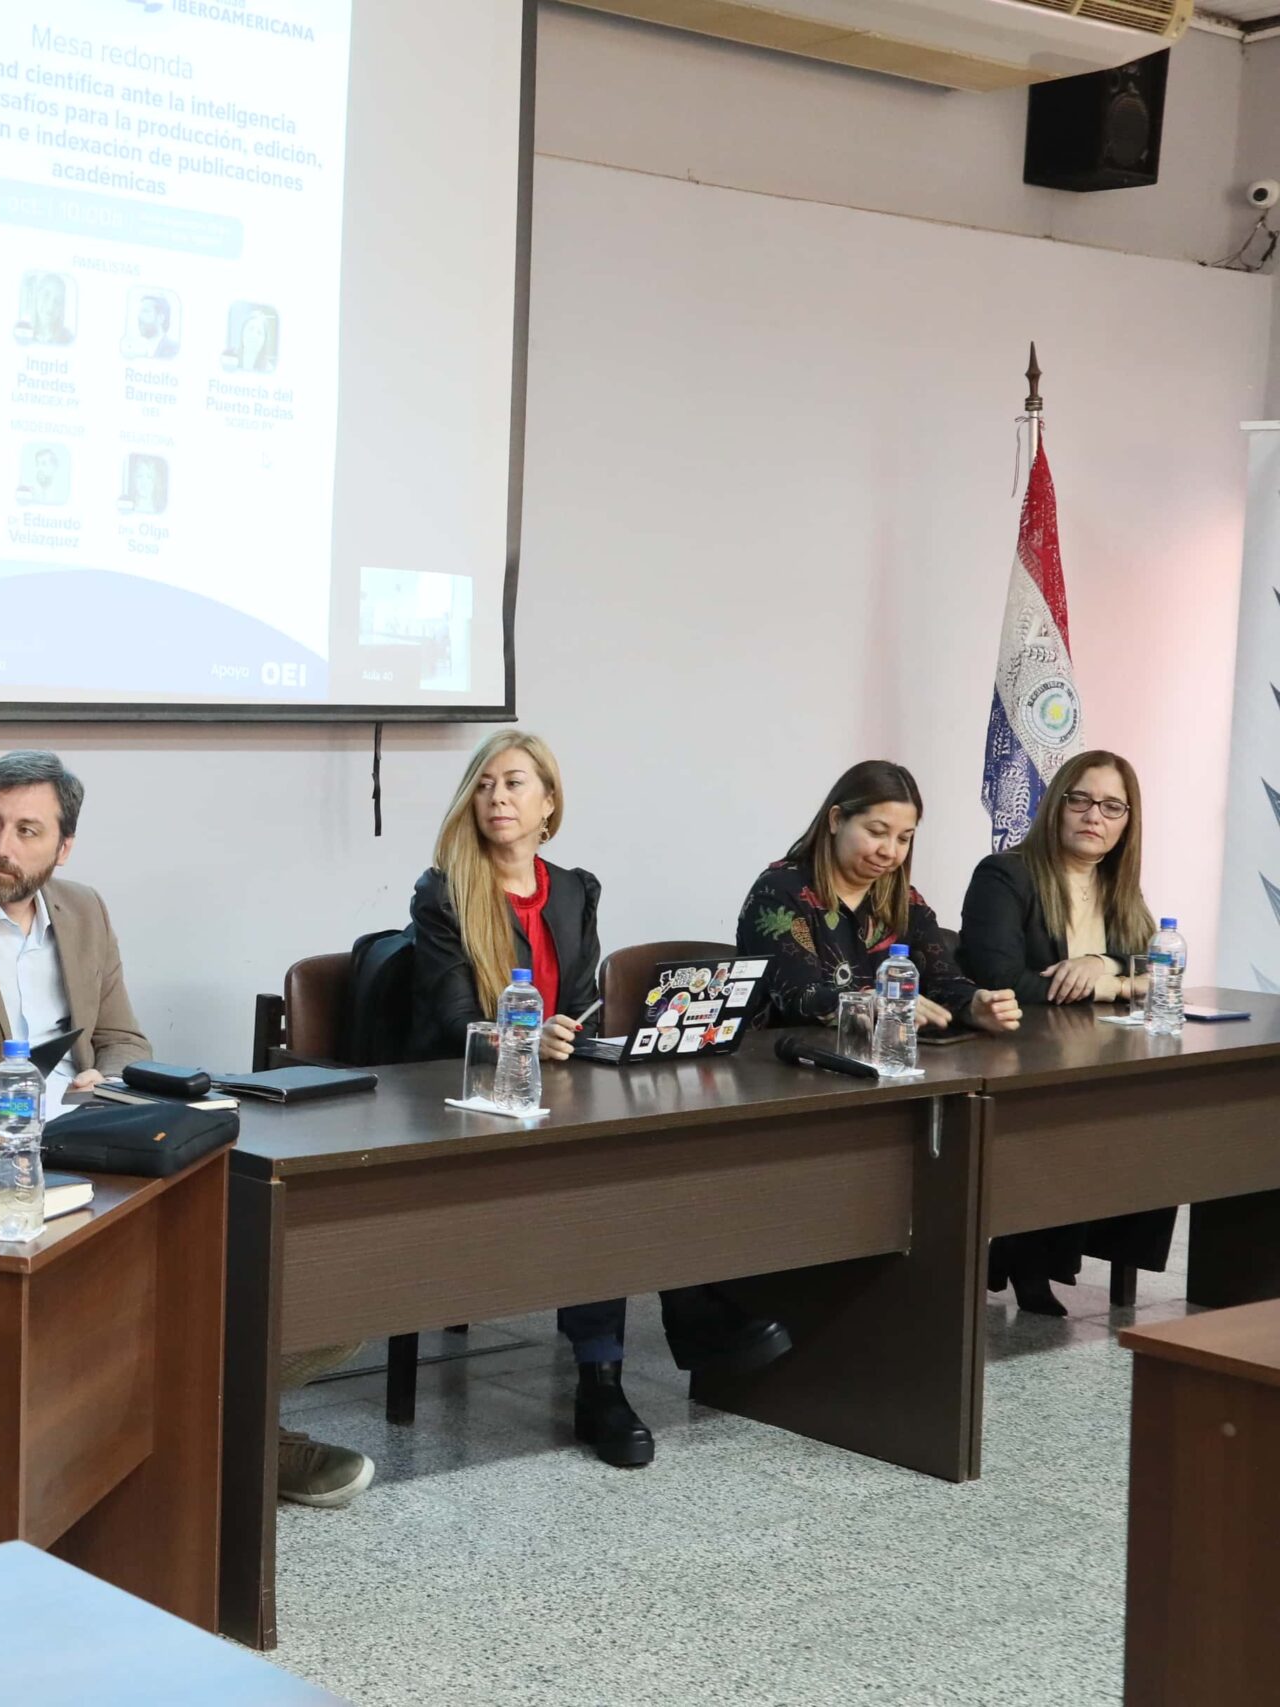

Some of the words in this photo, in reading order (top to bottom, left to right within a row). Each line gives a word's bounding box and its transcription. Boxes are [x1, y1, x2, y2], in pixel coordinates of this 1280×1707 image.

[172, 0, 316, 42] IBEROAMERICANA
[30, 23, 93, 60] Mesa
[101, 41, 194, 80] redonda
[25, 63, 114, 100] científica
[120, 84, 164, 110] ante
[169, 89, 185, 114] la
[191, 94, 297, 135] inteligencia
[65, 102, 109, 130] para
[116, 107, 132, 131] la
[18, 125, 30, 141] e
[36, 119, 142, 162] indexación
[148, 144, 172, 167] de
[179, 151, 304, 193] publicaciones
[51, 158, 168, 196] académicas
[26, 356, 69, 375] Ingrid
[125, 367, 179, 387] Rodolfo
[16, 373, 77, 394] Paredes
[208, 378, 269, 400] Florencia
[23, 511, 82, 531] Eduardo
[210, 662, 250, 680] Apoyo
[260, 660, 308, 687] OEI
